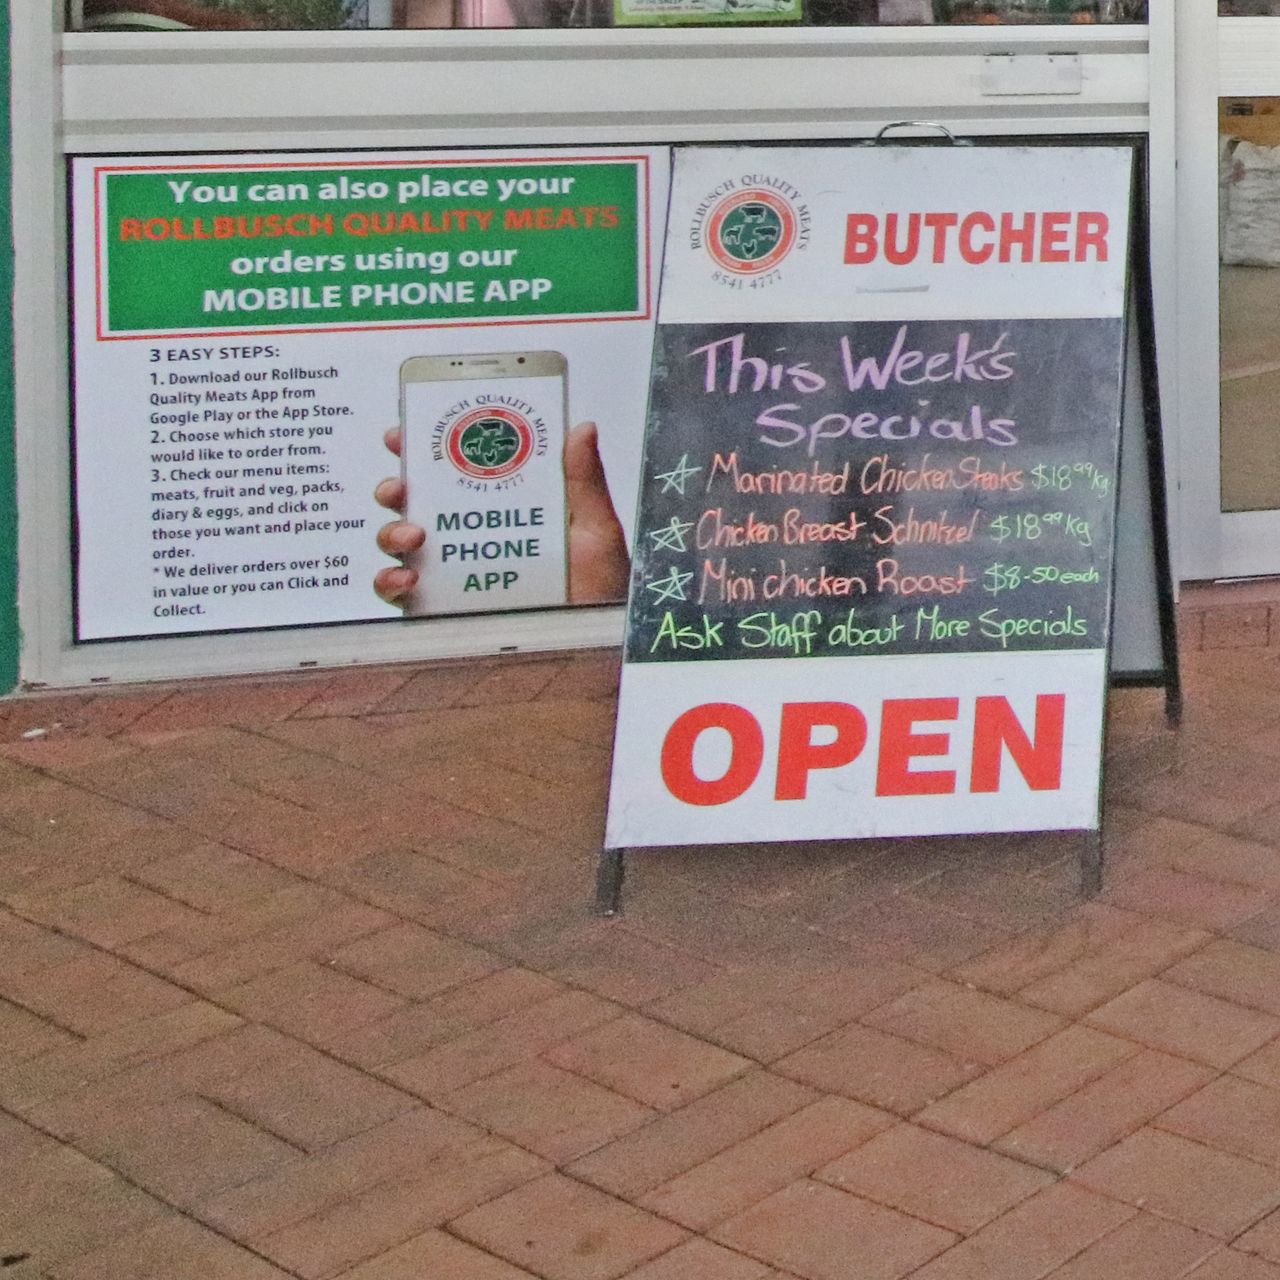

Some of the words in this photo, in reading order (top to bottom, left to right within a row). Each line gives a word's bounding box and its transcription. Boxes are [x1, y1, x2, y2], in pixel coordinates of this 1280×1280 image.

[167, 180, 238, 204] You
[247, 182, 309, 202] can
[318, 176, 389, 202] also
[398, 174, 489, 204] place
[496, 176, 576, 202] your
[119, 213, 334, 241] ROLLBUSCH
[343, 208, 494, 237] QUALITY
[504, 205, 620, 230] MEATS
[689, 178, 736, 250] ROLLBUSCH
[741, 173, 801, 201] QUALITY
[797, 204, 811, 250] MEATS
[842, 210, 1109, 266] BUTCHER
[229, 249, 346, 275] orders
[354, 247, 449, 275] using
[458, 248, 518, 267] our
[202, 284, 342, 312] MOBILE
[351, 280, 475, 307] PHONE
[483, 277, 553, 302] APP
[149, 348, 161, 362] 3
[167, 347, 213, 362] EASY
[219, 345, 281, 360] STEPS:
[687, 332, 827, 394] This
[169, 368, 240, 385] Download
[244, 370, 268, 382] our
[271, 366, 339, 381] Rollbusch
[149, 391, 201, 407] Quality
[205, 390, 248, 403] Meats
[252, 389, 279, 403] App
[282, 386, 316, 399] from
[149, 411, 200, 427] Google
[203, 409, 233, 424] Play
[236, 410, 252, 420] or
[255, 407, 279, 420] the
[282, 406, 309, 421] App
[312, 404, 354, 417] Store.
[169, 429, 220, 443] Choose
[223, 426, 265, 440] which
[269, 426, 305, 438] store
[308, 425, 333, 439] you
[755, 399, 1019, 458] Specials
[150, 449, 195, 463] would
[199, 448, 224, 461] like
[228, 447, 242, 459] to
[246, 445, 284, 458] order
[287, 443, 326, 457] from.
[170, 467, 211, 481] Check
[215, 467, 239, 478] our
[242, 465, 283, 477] menu
[286, 463, 330, 476] items:
[705, 451, 849, 495] Marinated
[860, 453, 952, 495] Chicken
[952, 455, 1025, 492] Steaks
[151, 488, 199, 501] meats,
[203, 486, 234, 498] fruit
[239, 484, 265, 497] and
[269, 485, 298, 497] veg,
[301, 481, 345, 495] packs,
[151, 508, 189, 522] diary
[192, 506, 203, 519] &
[206, 506, 244, 520] eggs,
[247, 502, 274, 516] and
[278, 500, 308, 514] click
[311, 501, 329, 512] on
[436, 507, 544, 531] MOBILE
[151, 528, 192, 540] those
[195, 526, 221, 541] you
[224, 523, 260, 536] want
[264, 520, 291, 534] and
[294, 519, 331, 534] place
[335, 518, 366, 533] your
[696, 507, 779, 550] Chicken
[783, 508, 867, 545] Breast
[872, 504, 981, 546] Schnitzel
[152, 547, 196, 560] order.
[441, 538, 541, 563] PHONE
[164, 565, 185, 578] We
[189, 561, 239, 576] deliver
[241, 559, 286, 573] orders
[289, 558, 319, 570] over
[324, 555, 349, 569] $60
[153, 586, 166, 598] in
[170, 583, 209, 597] value
[213, 583, 228, 594] or
[231, 582, 256, 596] you
[260, 581, 284, 592] can
[287, 576, 319, 590] Click
[322, 574, 349, 587] and
[463, 570, 519, 592] APP
[698, 557, 756, 606] Mini
[763, 558, 867, 600] chicken
[875, 558, 977, 596] Roast
[1059, 566, 1099, 584] each
[153, 603, 206, 618] Collect.
[650, 610, 724, 654] Ask
[737, 609, 822, 654] Staff
[828, 607, 905, 647] about
[915, 604, 971, 641] More
[978, 604, 1088, 649] Specials
[660, 693, 1067, 808] OPEN
